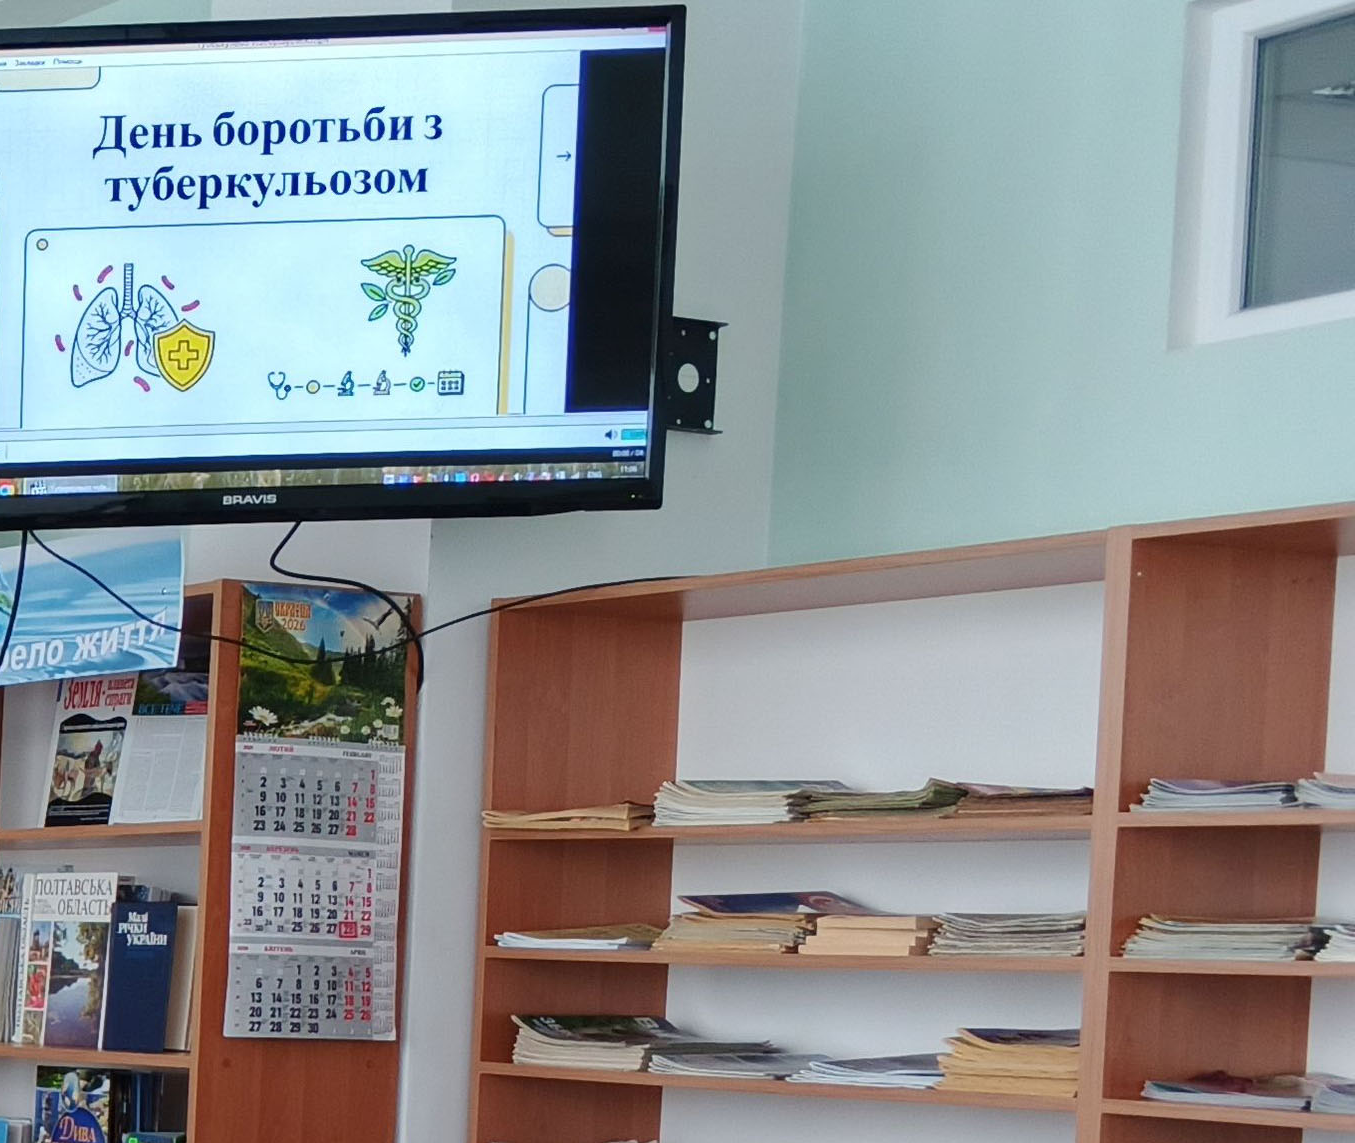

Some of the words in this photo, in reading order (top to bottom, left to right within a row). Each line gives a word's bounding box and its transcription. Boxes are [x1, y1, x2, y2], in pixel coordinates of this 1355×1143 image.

[92, 114, 203, 159] День
[213, 106, 414, 155] боротьби
[424, 114, 443, 140] з
[104, 165, 429, 212] туберкульозом
[222, 494, 277, 505] BRAVIS
[282, 618, 306, 631] 2026
[74, 607, 168, 662] життя
[260, 777, 266, 787] 2
[281, 779, 286, 788] 3
[299, 780, 305, 788] 4
[317, 781, 322, 790] 5
[335, 782, 340, 791] 6
[352, 783, 358, 793] 7
[260, 792, 266, 801] 9
[276, 793, 286, 802] 10
[295, 793, 304, 803] 11
[313, 795, 322, 804] 12
[330, 796, 339, 806] 13
[347, 797, 357, 807] 14
[366, 798, 375, 808] 15
[255, 806, 266, 816] 16
[276, 807, 285, 817] 17
[295, 808, 304, 818] 18
[313, 809, 321, 819] 19
[329, 810, 339, 820] 20
[347, 811, 356, 821] 21
[364, 812, 374, 823] 22
[254, 821, 265, 831] 23
[274, 821, 285, 832] 24
[293, 822, 304, 832] 25
[311, 823, 321, 834] 26
[328, 824, 338, 835] 27
[367, 868, 371, 879] 1
[34, 878, 113, 896] ПОЛТАВСЬКА
[258, 877, 264, 888] 2
[279, 878, 284, 888] 3
[298, 879, 303, 889] 4
[315, 880, 320, 890] 5
[332, 881, 337, 891] 6
[349, 882, 354, 892] 7
[258, 892, 263, 902] 9
[274, 893, 284, 903] 10
[294, 893, 302, 903] 11
[311, 894, 320, 904] 12
[328, 895, 337, 905] 13
[345, 896, 354, 906] 14
[362, 897, 371, 907] 15
[57, 899, 111, 916] ОБЛАСТЬ
[252, 906, 263, 917] 16
[274, 907, 283, 917] 17
[293, 908, 302, 918] 18
[311, 909, 319, 919] 19
[327, 909, 337, 920] 20
[344, 910, 353, 920] 21
[361, 911, 371, 921] 22
[118, 922, 148, 934] РІЧКИ
[292, 922, 303, 933] 25
[310, 923, 320, 933] 26
[326, 924, 337, 934] 27
[361, 925, 371, 935] 29
[126, 932, 168, 946] УКРАЇНИ
[297, 965, 301, 975] 1
[314, 966, 319, 976] 2
[332, 966, 337, 976] 3
[348, 967, 353, 977] 4
[366, 968, 371, 978] 5
[256, 978, 262, 988] 6
[277, 979, 283, 989] 7
[296, 980, 301, 990] 8
[314, 980, 319, 990] 9
[327, 981, 336, 991] 10
[345, 982, 353, 992] 11
[362, 982, 371, 992] 12
[251, 992, 262, 1003] 13
[272, 993, 281, 1003] 14
[292, 994, 301, 1004] 15
[310, 995, 318, 1004] 16
[327, 995, 336, 1005] 17
[345, 996, 354, 1006] 18
[362, 996, 370, 1006] 19
[249, 1007, 261, 1018] 20
[270, 1007, 281, 1018] 21
[290, 1008, 301, 1019] 22
[308, 1009, 318, 1019] 23
[326, 1009, 336, 1019] 24
[344, 1010, 354, 1020] 25
[361, 1010, 371, 1021] 26
[249, 1021, 261, 1032] 27
[270, 1022, 282, 1032] 28
[290, 1022, 301, 1033] 29
[308, 1023, 318, 1033] 30
